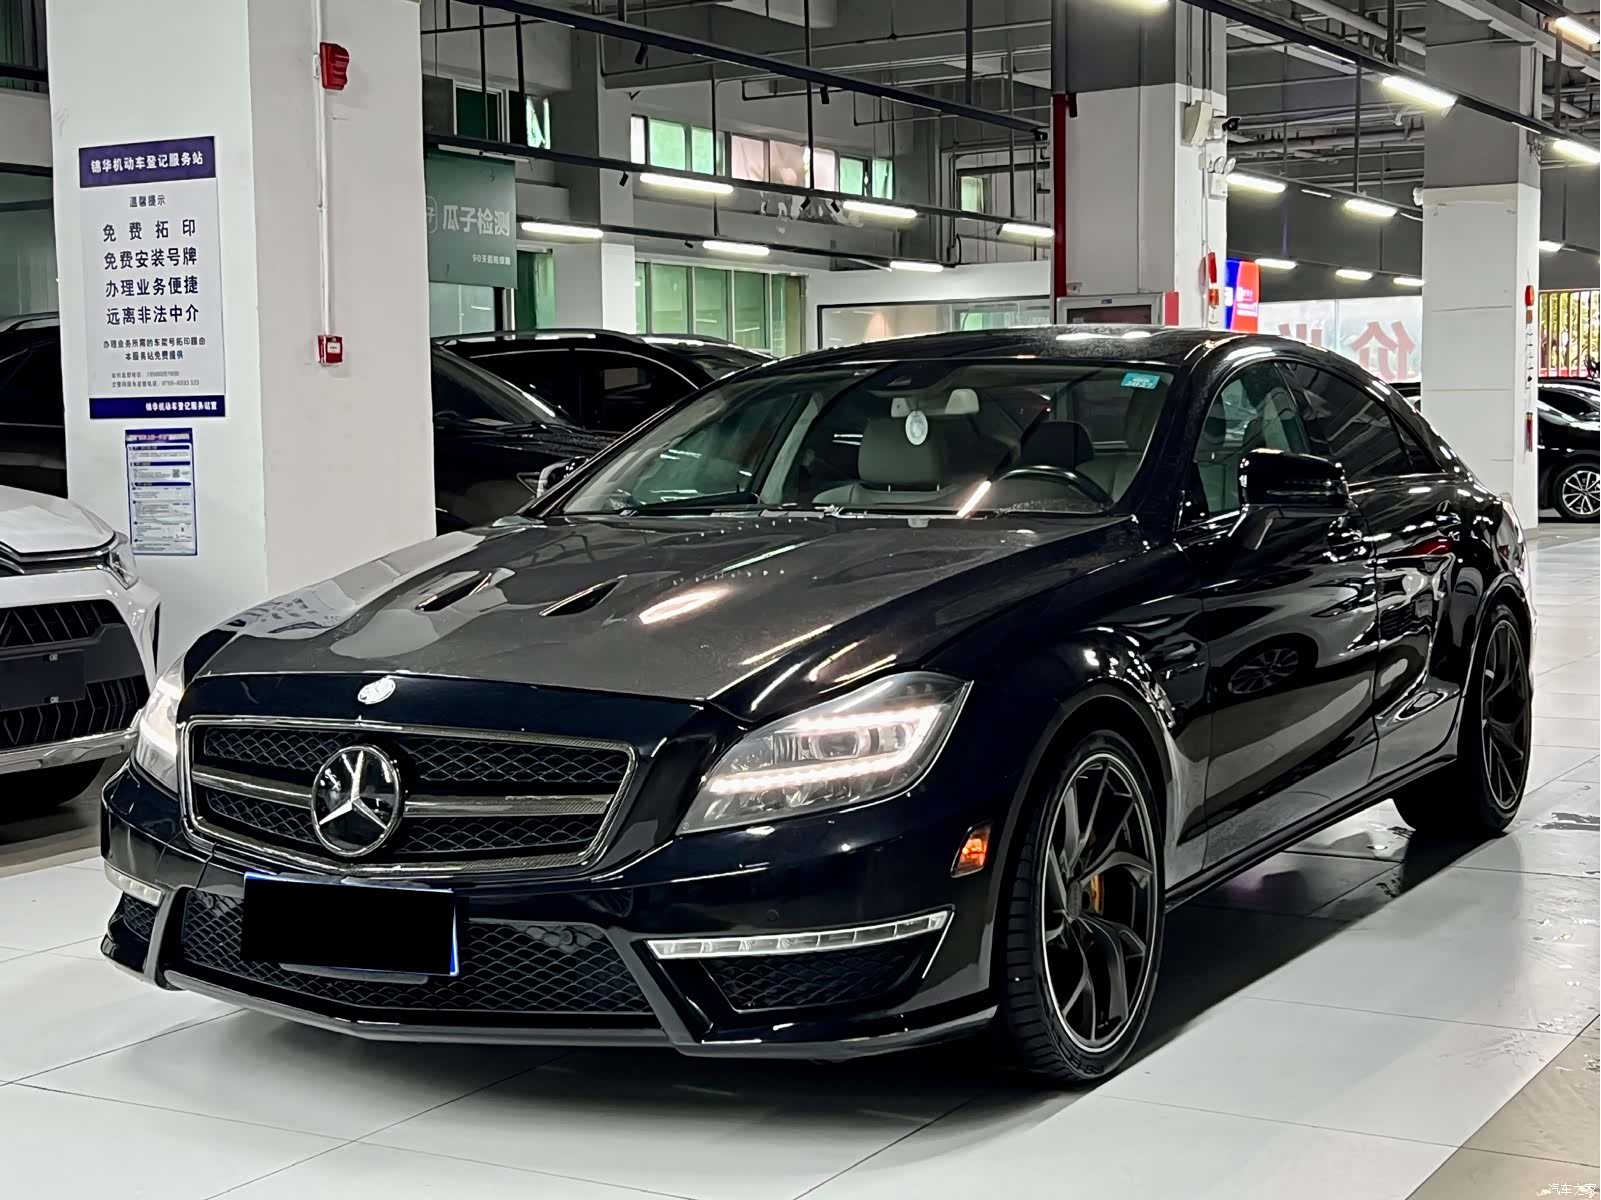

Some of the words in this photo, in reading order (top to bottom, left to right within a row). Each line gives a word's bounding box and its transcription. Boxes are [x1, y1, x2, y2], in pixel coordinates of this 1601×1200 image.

[90, 151, 203, 174] 锦华机动车登记服务站
[129, 194, 166, 208] 温馨提示
[442, 204, 510, 237] 瓜子检测
[104, 246, 198, 270] 免费安装号牌
[105, 275, 199, 298] 办理业务便捷
[106, 303, 199, 326] 远离非法中介
